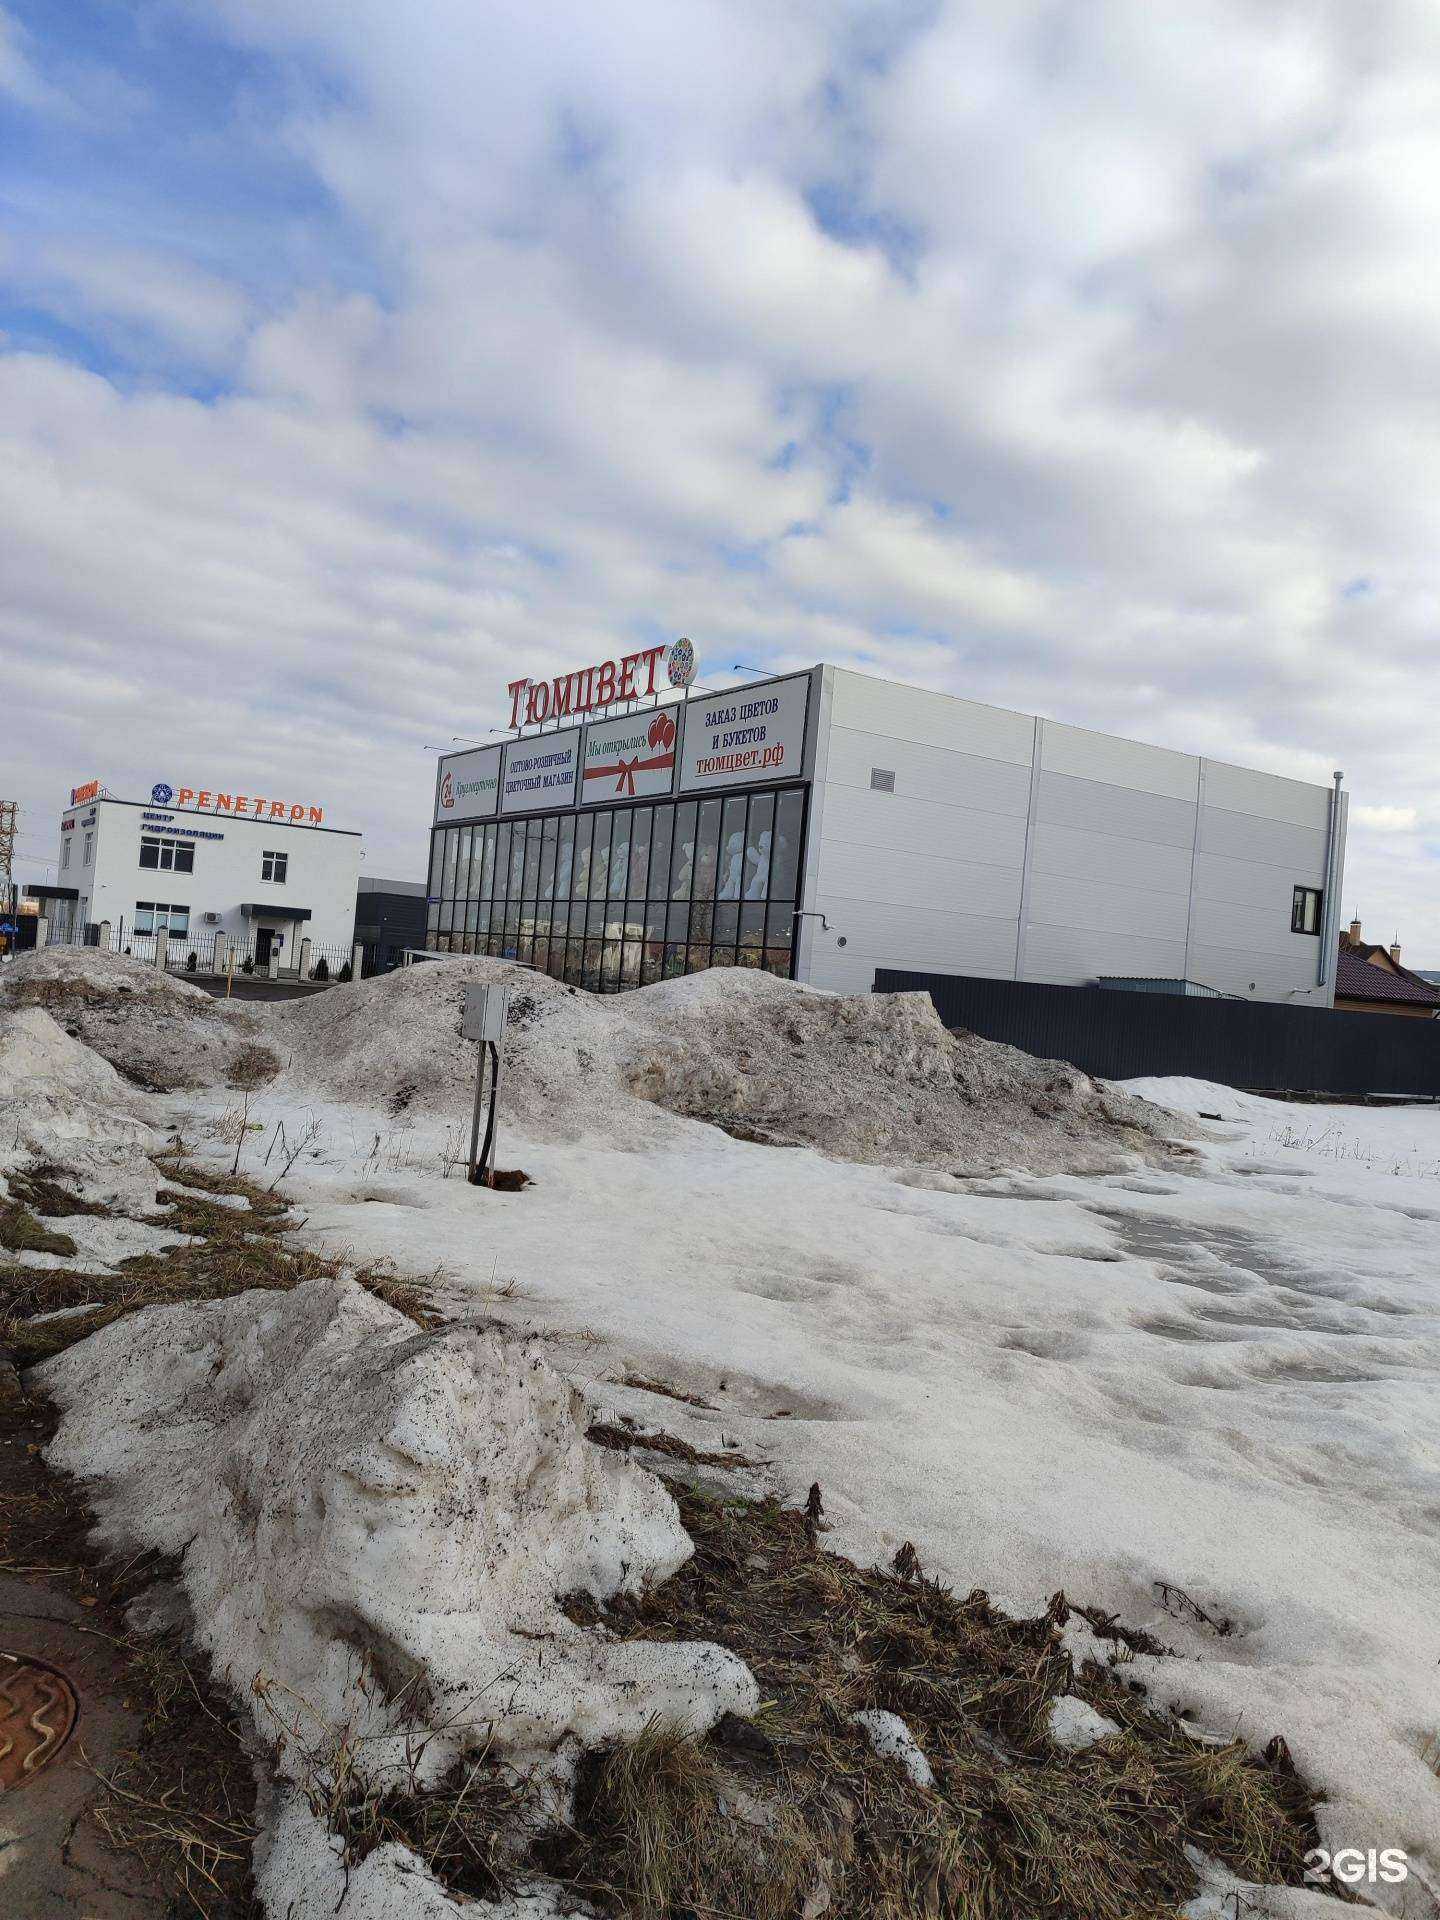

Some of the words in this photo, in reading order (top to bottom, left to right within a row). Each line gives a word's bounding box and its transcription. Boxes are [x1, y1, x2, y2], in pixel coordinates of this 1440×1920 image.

[705, 707, 737, 727] ЗАКАЗ
[739, 697, 779, 723] ЦВЕТОВ
[587, 740, 601, 758] Мы
[602, 735, 647, 757] открылись
[711, 734, 720, 750] И
[722, 726, 767, 748] БУКЕТОВ
[696, 742, 784, 774] тюмцвет.рф
[505, 775, 542, 796] ЦВЕТОЧНЫЙ
[543, 771, 574, 788] МАГАЗИН
[142, 811, 175, 823] ЦЕНТР
[178, 788, 323, 823] PENETRON
[141, 823, 225, 841] ГИДРОИЗОЛЯЦИИ
